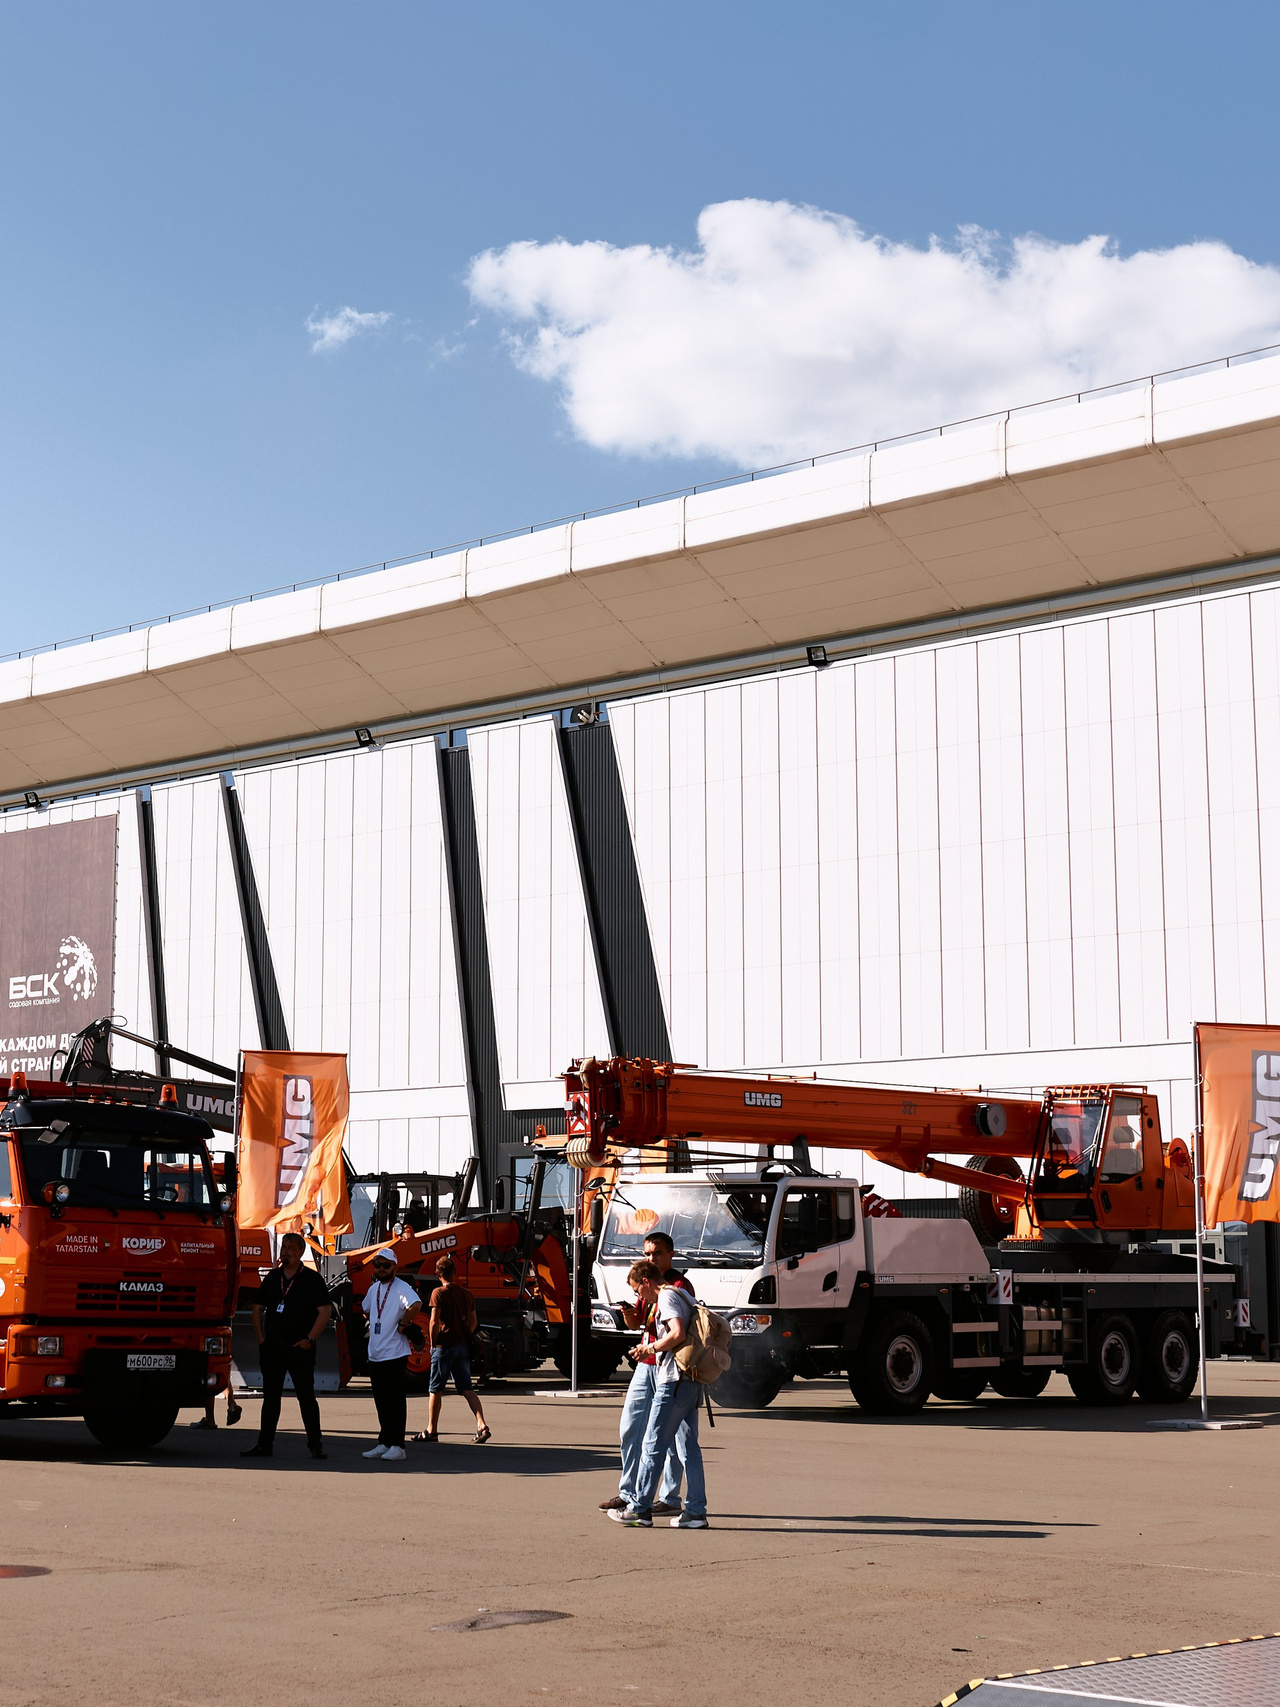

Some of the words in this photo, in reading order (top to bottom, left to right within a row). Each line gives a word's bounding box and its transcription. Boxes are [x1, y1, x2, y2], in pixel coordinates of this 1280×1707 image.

[9, 972, 60, 1000] БСК
[8, 999, 32, 1008] содовая
[32, 997, 61, 1006] компания
[186, 1093, 241, 1117] UMG
[745, 1092, 782, 1107] UMG
[1243, 1054, 1280, 1198] UMG
[278, 1078, 311, 1206] UMG
[66, 1235, 88, 1243] MADE
[122, 1237, 163, 1250] КОРИБ
[421, 1235, 457, 1254] UMG
[55, 1244, 98, 1253] TATARSTAN
[119, 1282, 164, 1293] КАМАЗ
